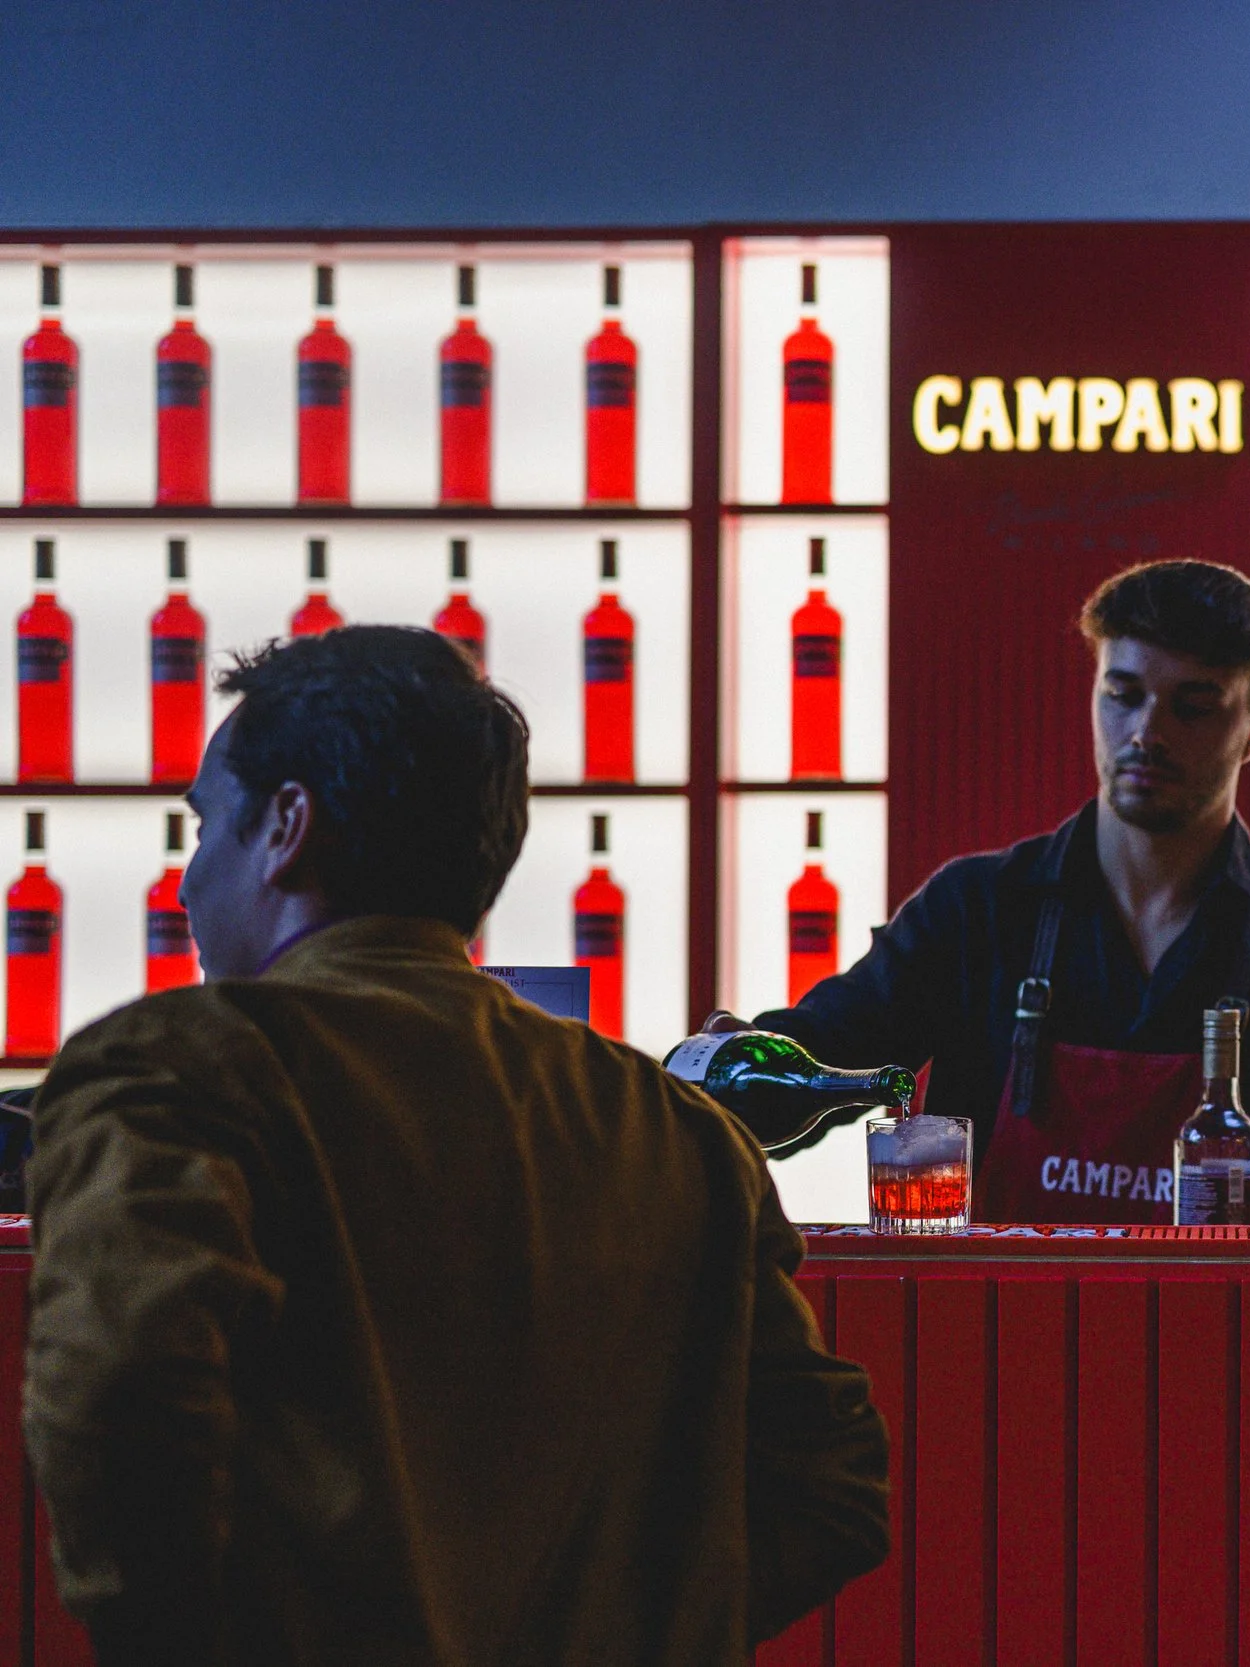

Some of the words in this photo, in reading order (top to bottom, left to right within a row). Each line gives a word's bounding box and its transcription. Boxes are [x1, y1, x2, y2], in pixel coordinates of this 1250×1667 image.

[912, 374, 1245, 454] CAMPARI
[476, 967, 515, 977] AMPARI
[1041, 1155, 1174, 1203] CAMPAR
